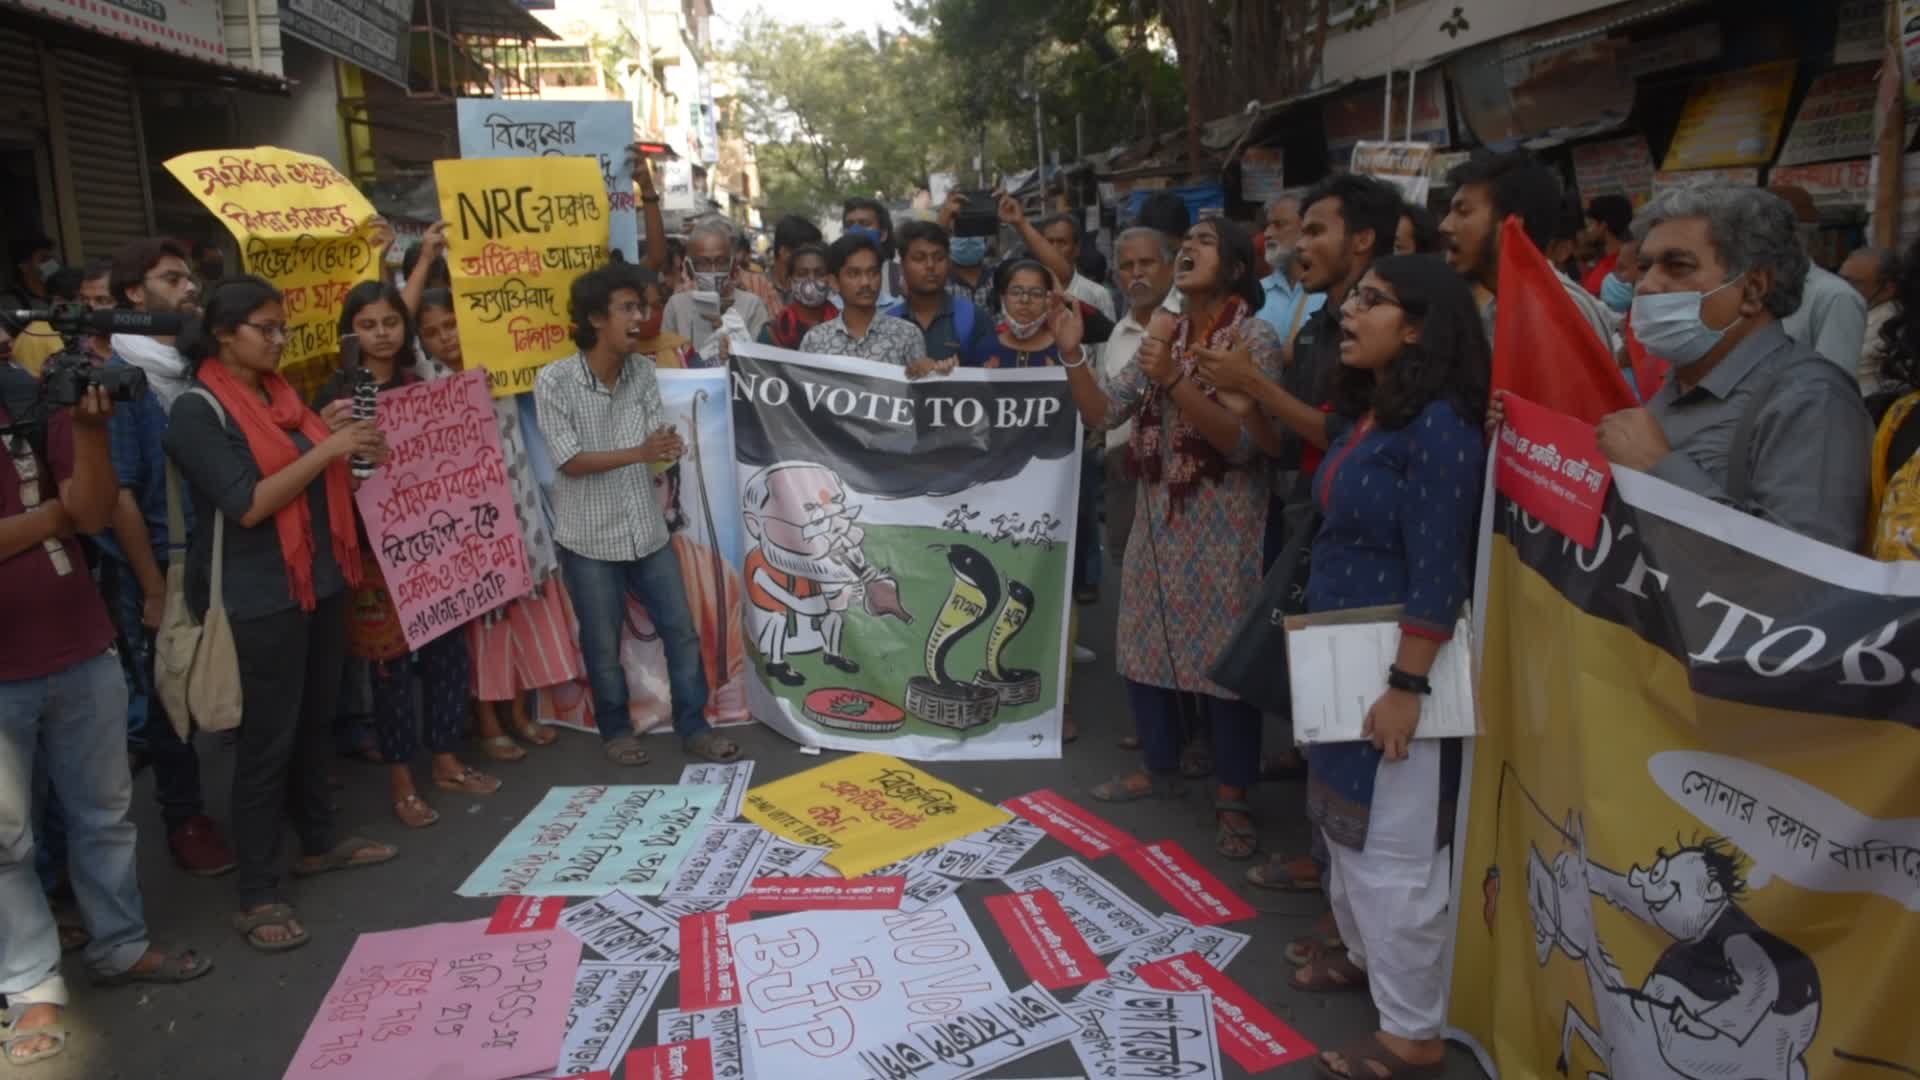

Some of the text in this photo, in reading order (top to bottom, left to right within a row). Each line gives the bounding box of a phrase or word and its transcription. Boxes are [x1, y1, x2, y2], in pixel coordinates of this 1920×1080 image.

[731, 371, 1061, 429] NO VOTE TO BJP
[1689, 591, 1827, 677] TO
[1682, 770, 1759, 824] সোনার
[883, 908, 971, 965] NO
[734, 926, 856, 1058] BJP
